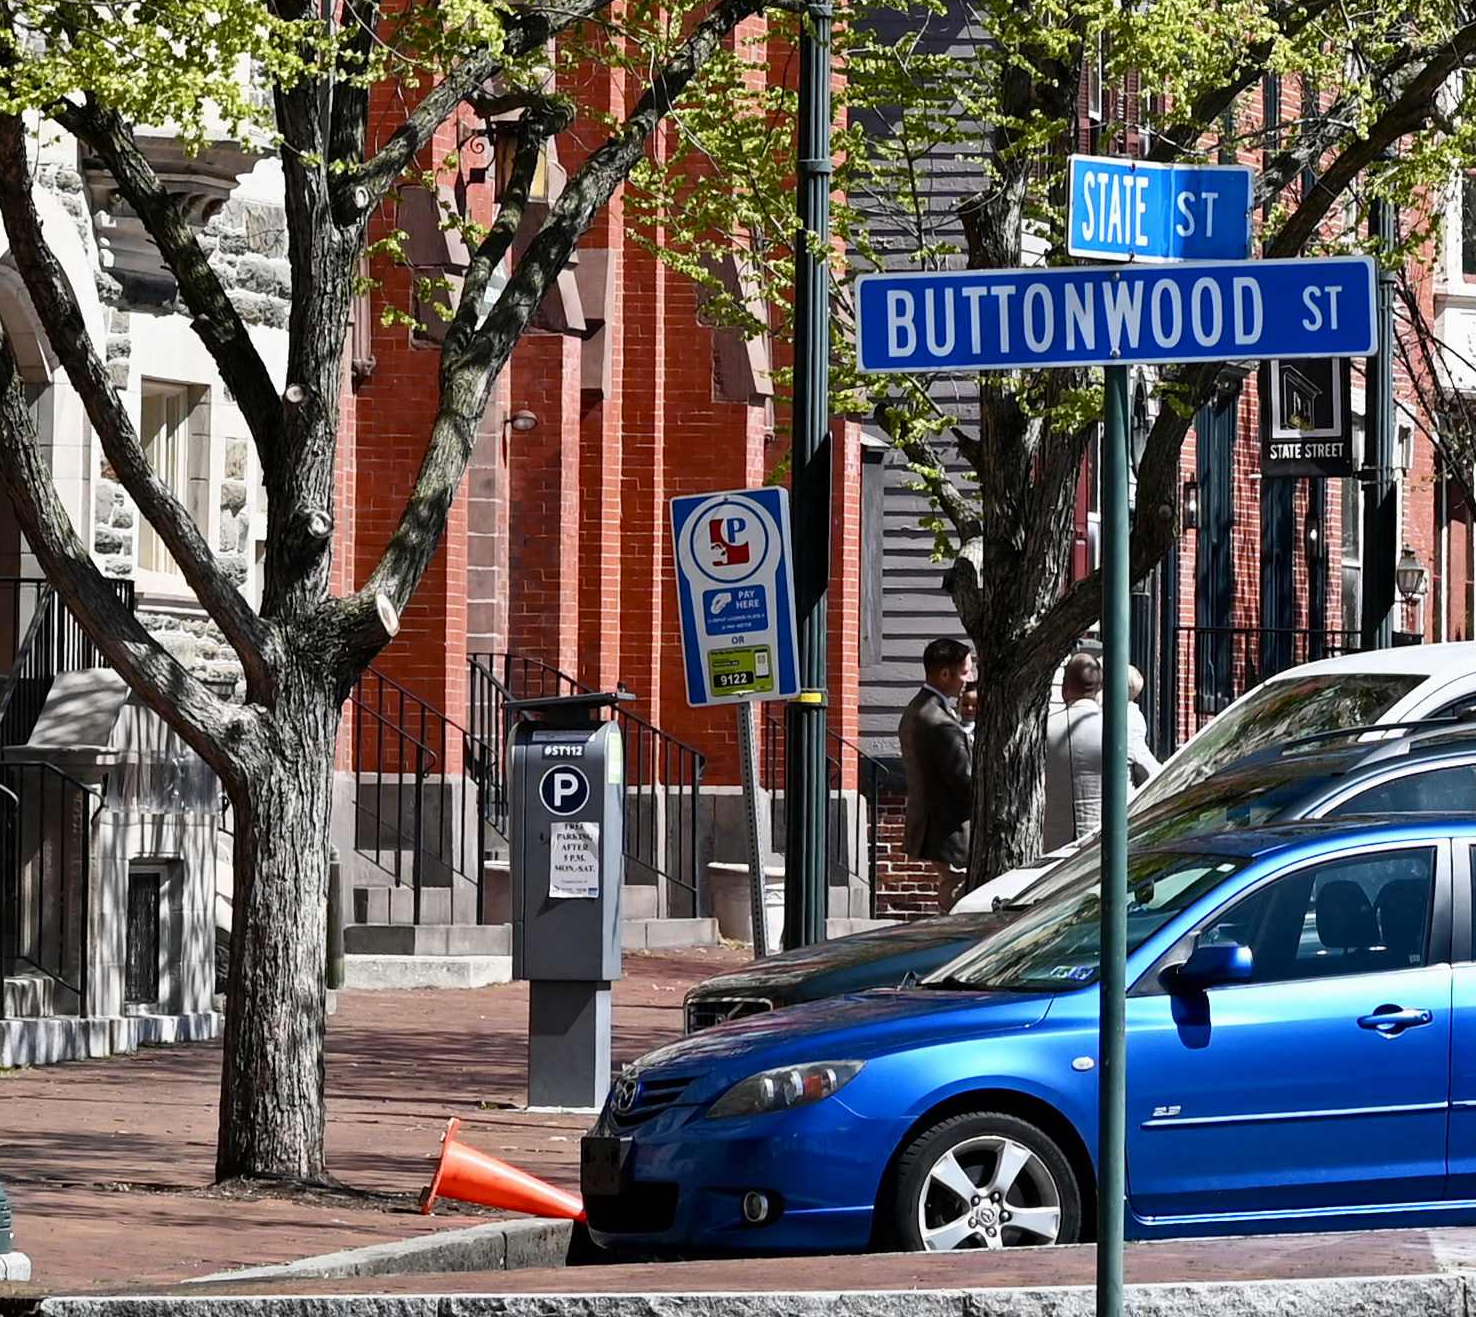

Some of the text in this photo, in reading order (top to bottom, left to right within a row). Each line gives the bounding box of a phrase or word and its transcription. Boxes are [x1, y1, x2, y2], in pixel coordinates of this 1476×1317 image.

[1081, 170, 1219, 247] STATE ST
[886, 276, 1343, 358] BUTTONWOOD ST
[1269, 442, 1344, 459] STATE STREET
[737, 590, 756, 600] PAY
[736, 599, 760, 610] HERE
[731, 635, 745, 644] OR
[720, 672, 747, 685] 9122
[553, 772, 579, 807] P
